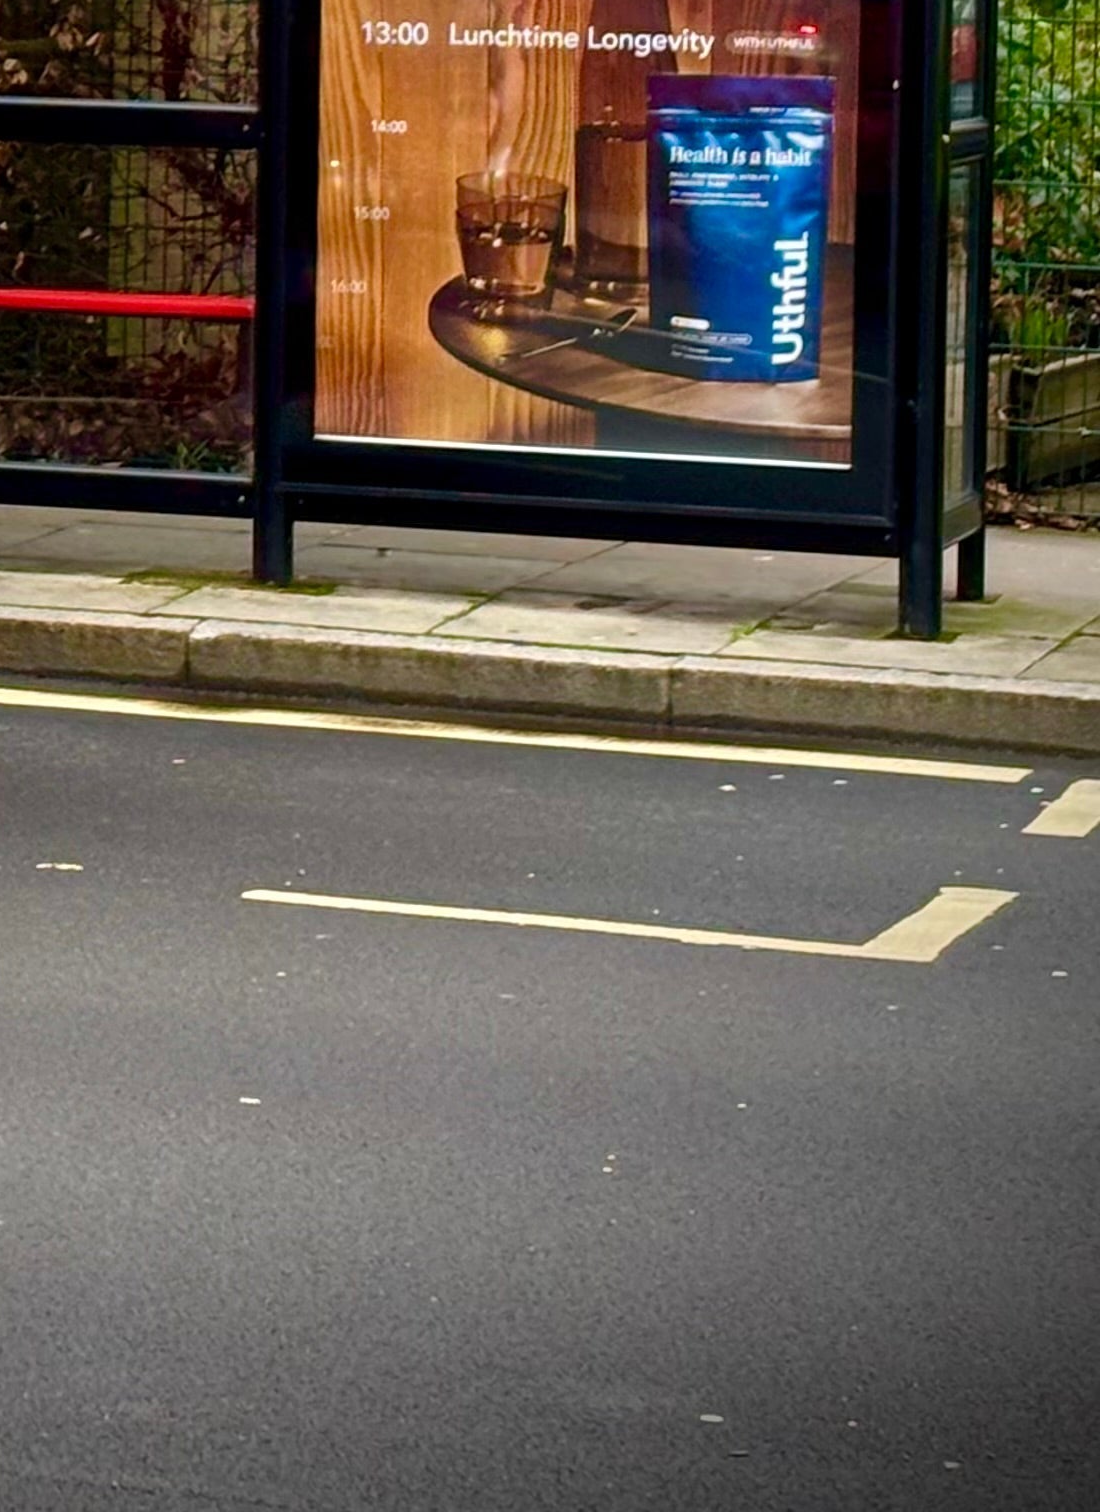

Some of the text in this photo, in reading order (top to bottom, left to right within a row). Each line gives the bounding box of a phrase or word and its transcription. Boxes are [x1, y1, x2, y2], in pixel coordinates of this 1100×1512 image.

[361, 21, 429, 46] 13:00
[449, 24, 579, 49] Lunchtime
[587, 26, 715, 58] Longevity
[371, 120, 407, 134] 14:00
[669, 145, 813, 167] Health is a habit
[354, 206, 390, 220] 15:00
